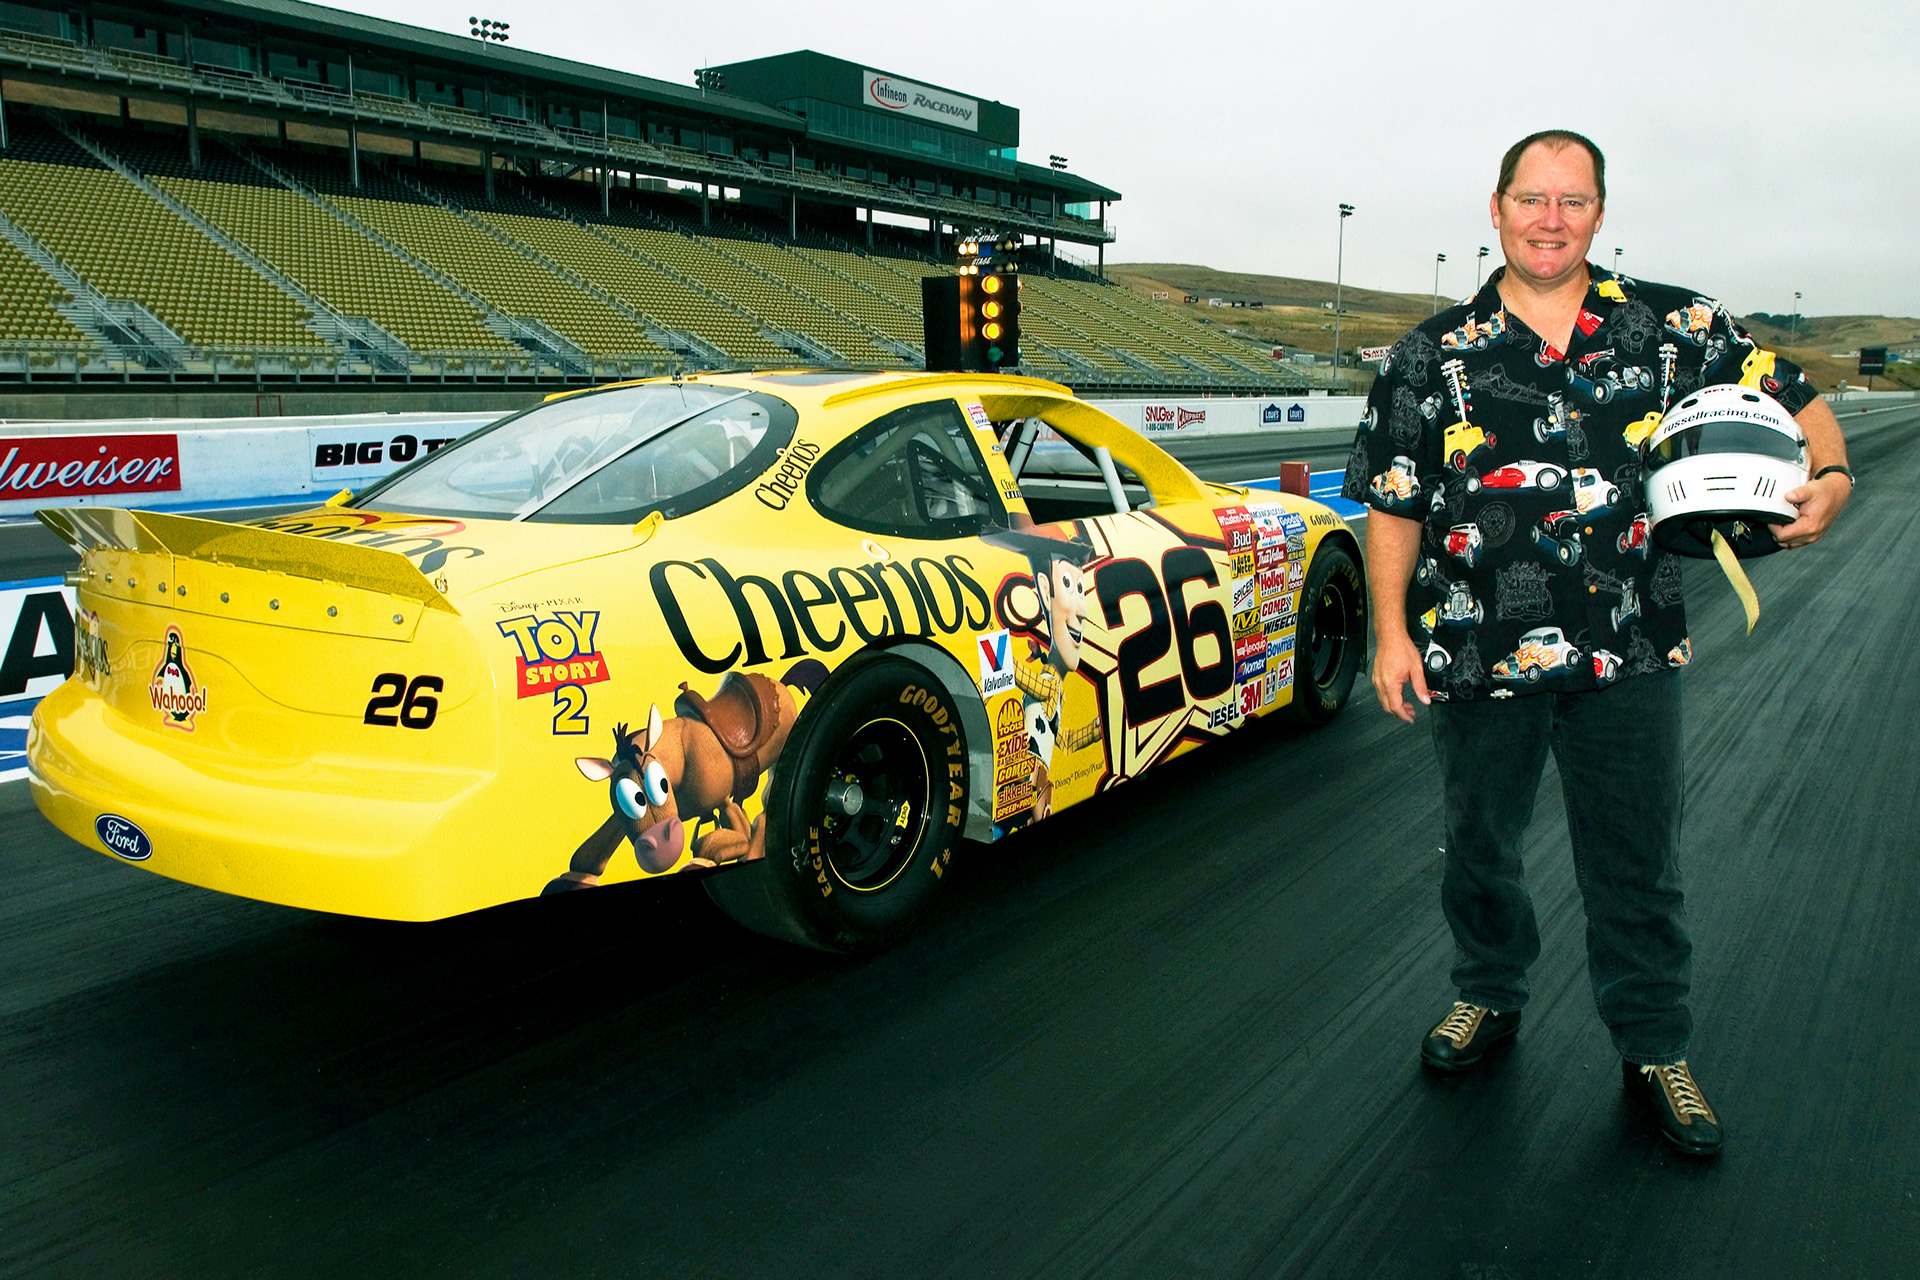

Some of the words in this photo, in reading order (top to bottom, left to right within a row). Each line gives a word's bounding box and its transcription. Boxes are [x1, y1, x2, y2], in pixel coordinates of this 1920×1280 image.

[913, 93, 972, 121] RACEWAY
[1663, 408, 1780, 434] russellracing.com
[315, 441, 383, 467] BIG
[389, 434, 418, 462] O
[755, 439, 820, 511] Cheerios
[1233, 528, 1252, 548] Bud
[1237, 554, 1251, 564] Auto
[1237, 563, 1254, 574] Meter
[1234, 579, 1254, 604] SPICER
[1260, 569, 1285, 592] Holley
[649, 554, 991, 674] Cheerios
[1262, 598, 1286, 617] COMP
[496, 611, 600, 665] TOY
[1094, 546, 1214, 730] 26
[1263, 613, 1297, 636] WISECO
[525, 661, 600, 685] STORY
[984, 673, 1014, 694] Valvoline
[149, 685, 207, 713] Wahooo!
[363, 673, 444, 730] 26
[553, 683, 589, 735] 2
[1240, 680, 1262, 715] 3M
[999, 700, 1024, 727] MAC
[1207, 701, 1240, 730] JESEL
[999, 721, 1024, 736] TOOLS
[900, 685, 963, 827] GOODYEAR
[997, 732, 1029, 759] EXIDE
[998, 760, 1028, 782] COMP
[998, 781, 1033, 804] sikkens
[106, 822, 141, 855] Ford
[809, 826, 833, 898] EAGLE
